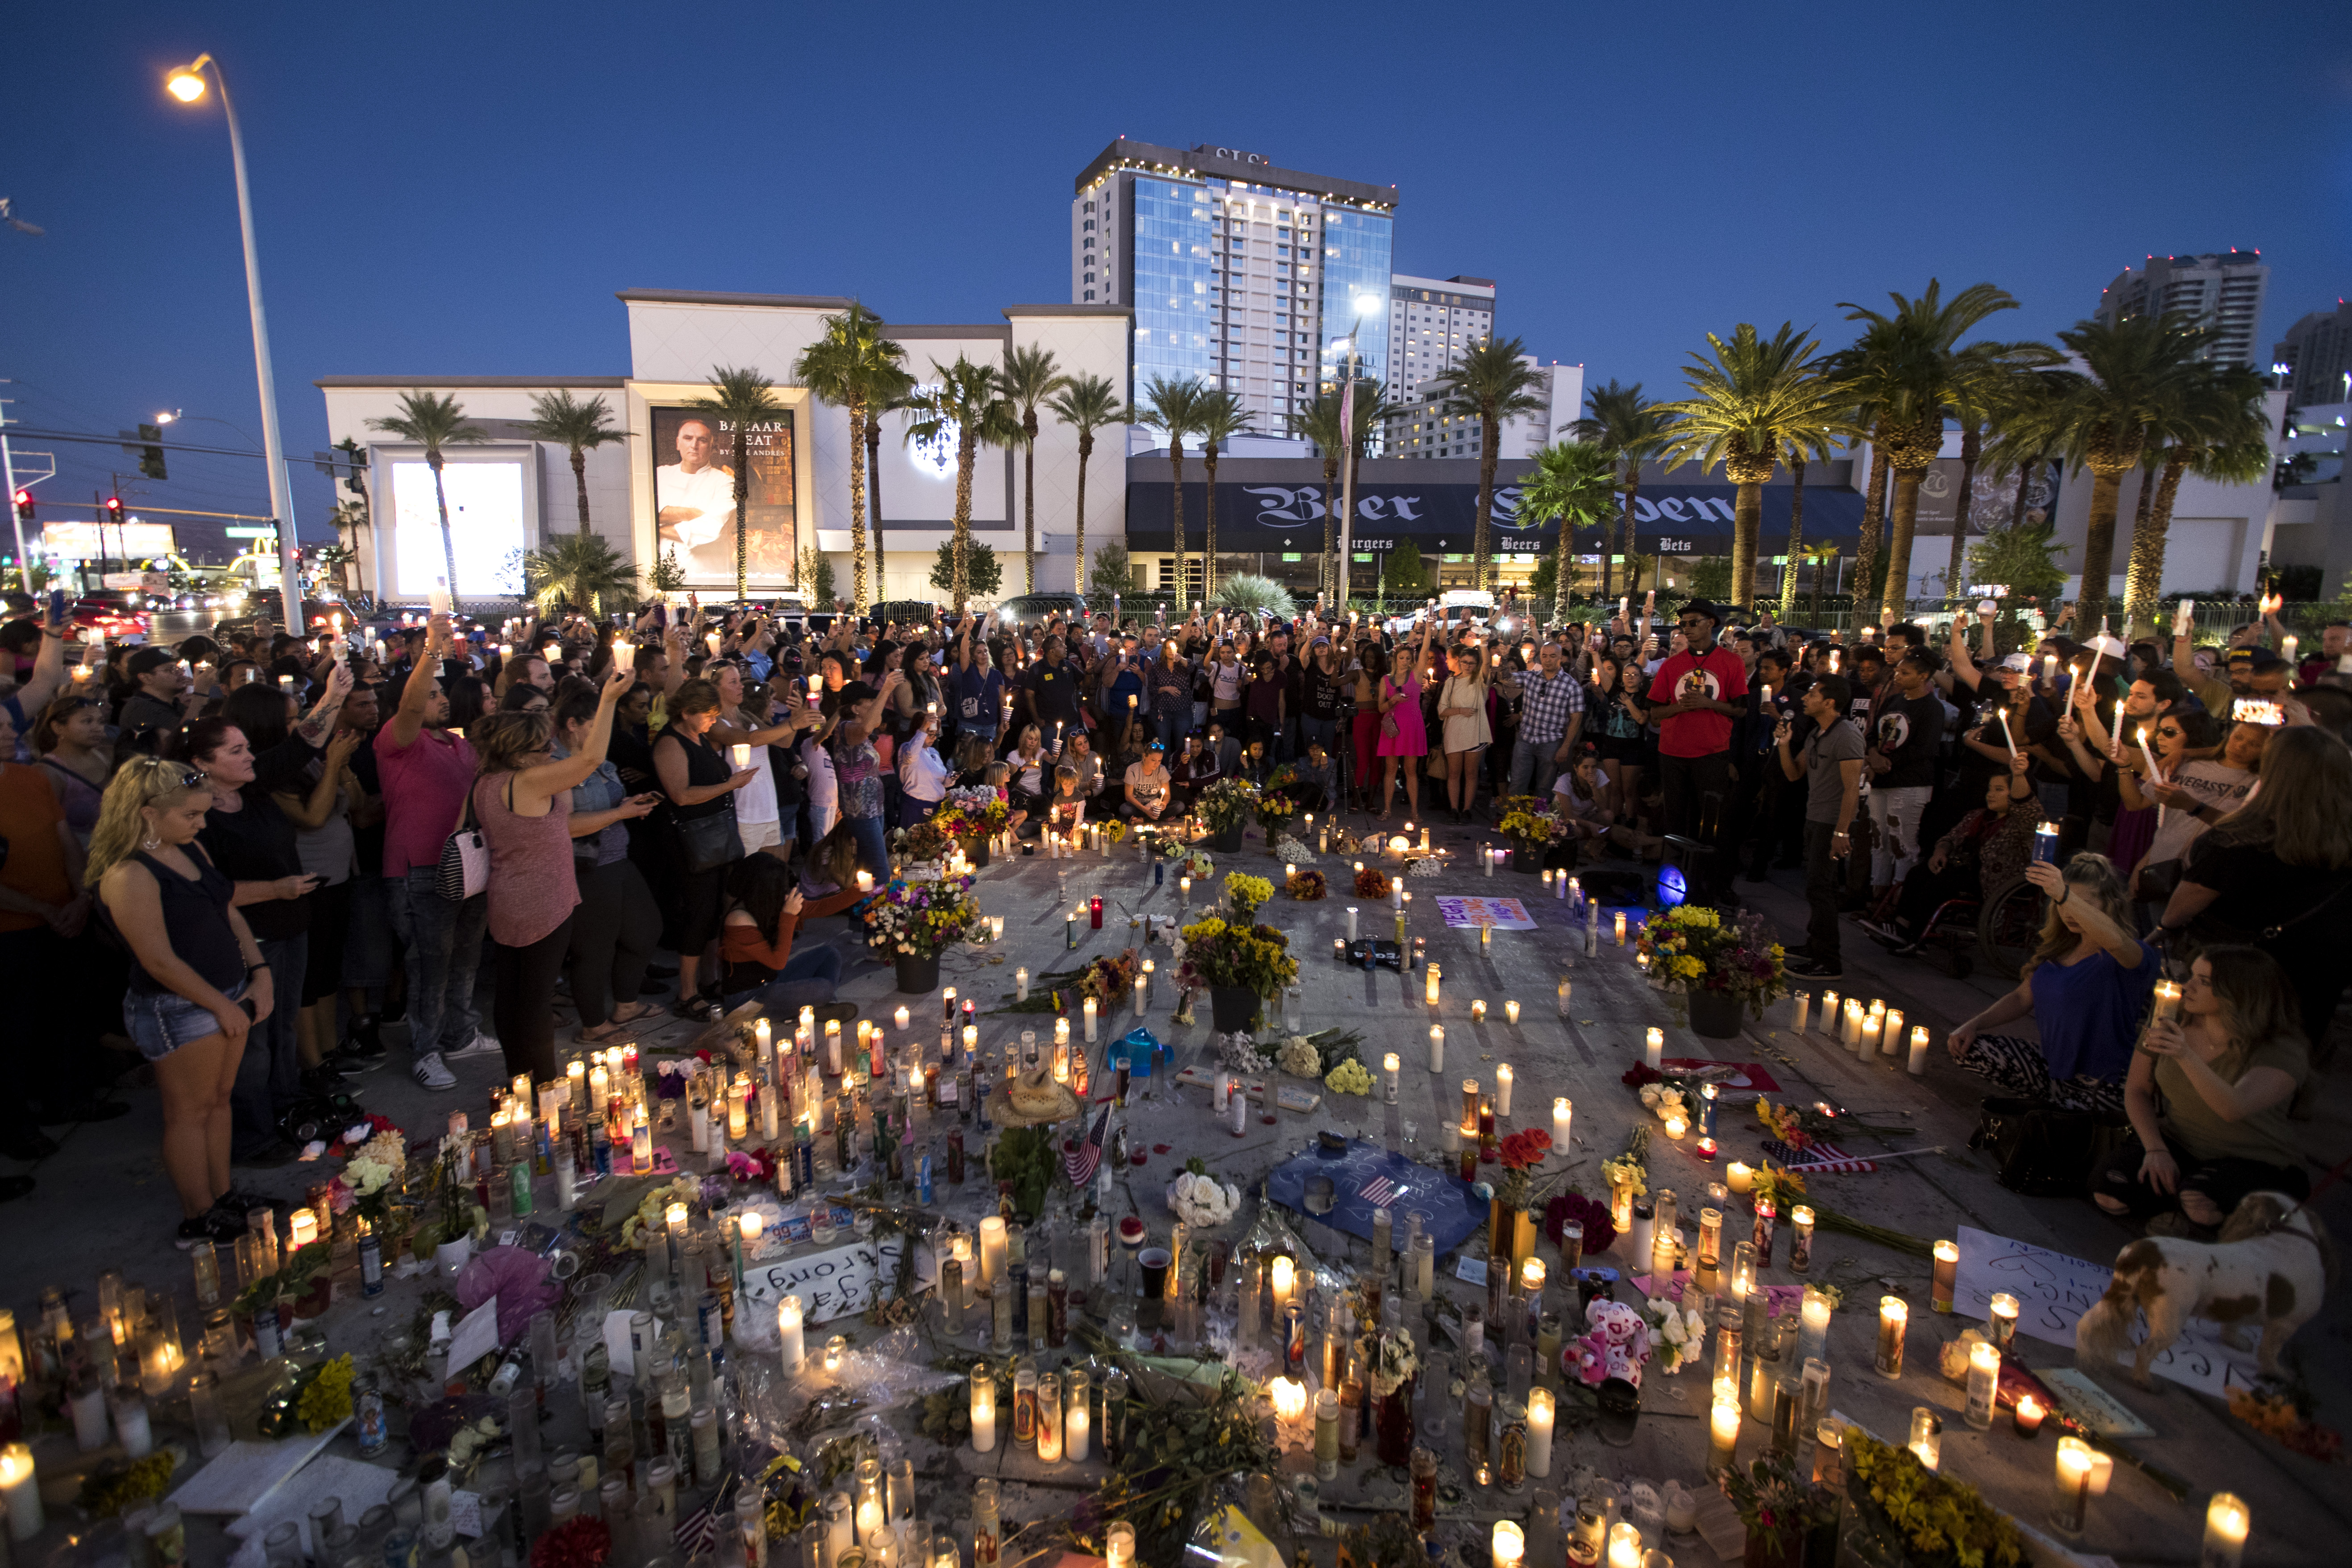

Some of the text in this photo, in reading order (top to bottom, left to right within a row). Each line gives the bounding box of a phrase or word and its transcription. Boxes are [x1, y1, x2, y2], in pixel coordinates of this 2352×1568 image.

[731, 435, 773, 445] EAT
[1501, 536, 1541, 550] Beers
[1660, 537, 1692, 552] Bets
[1317, 692, 1334, 700] DOGS
[1437, 899, 1469, 927] VEGAS
